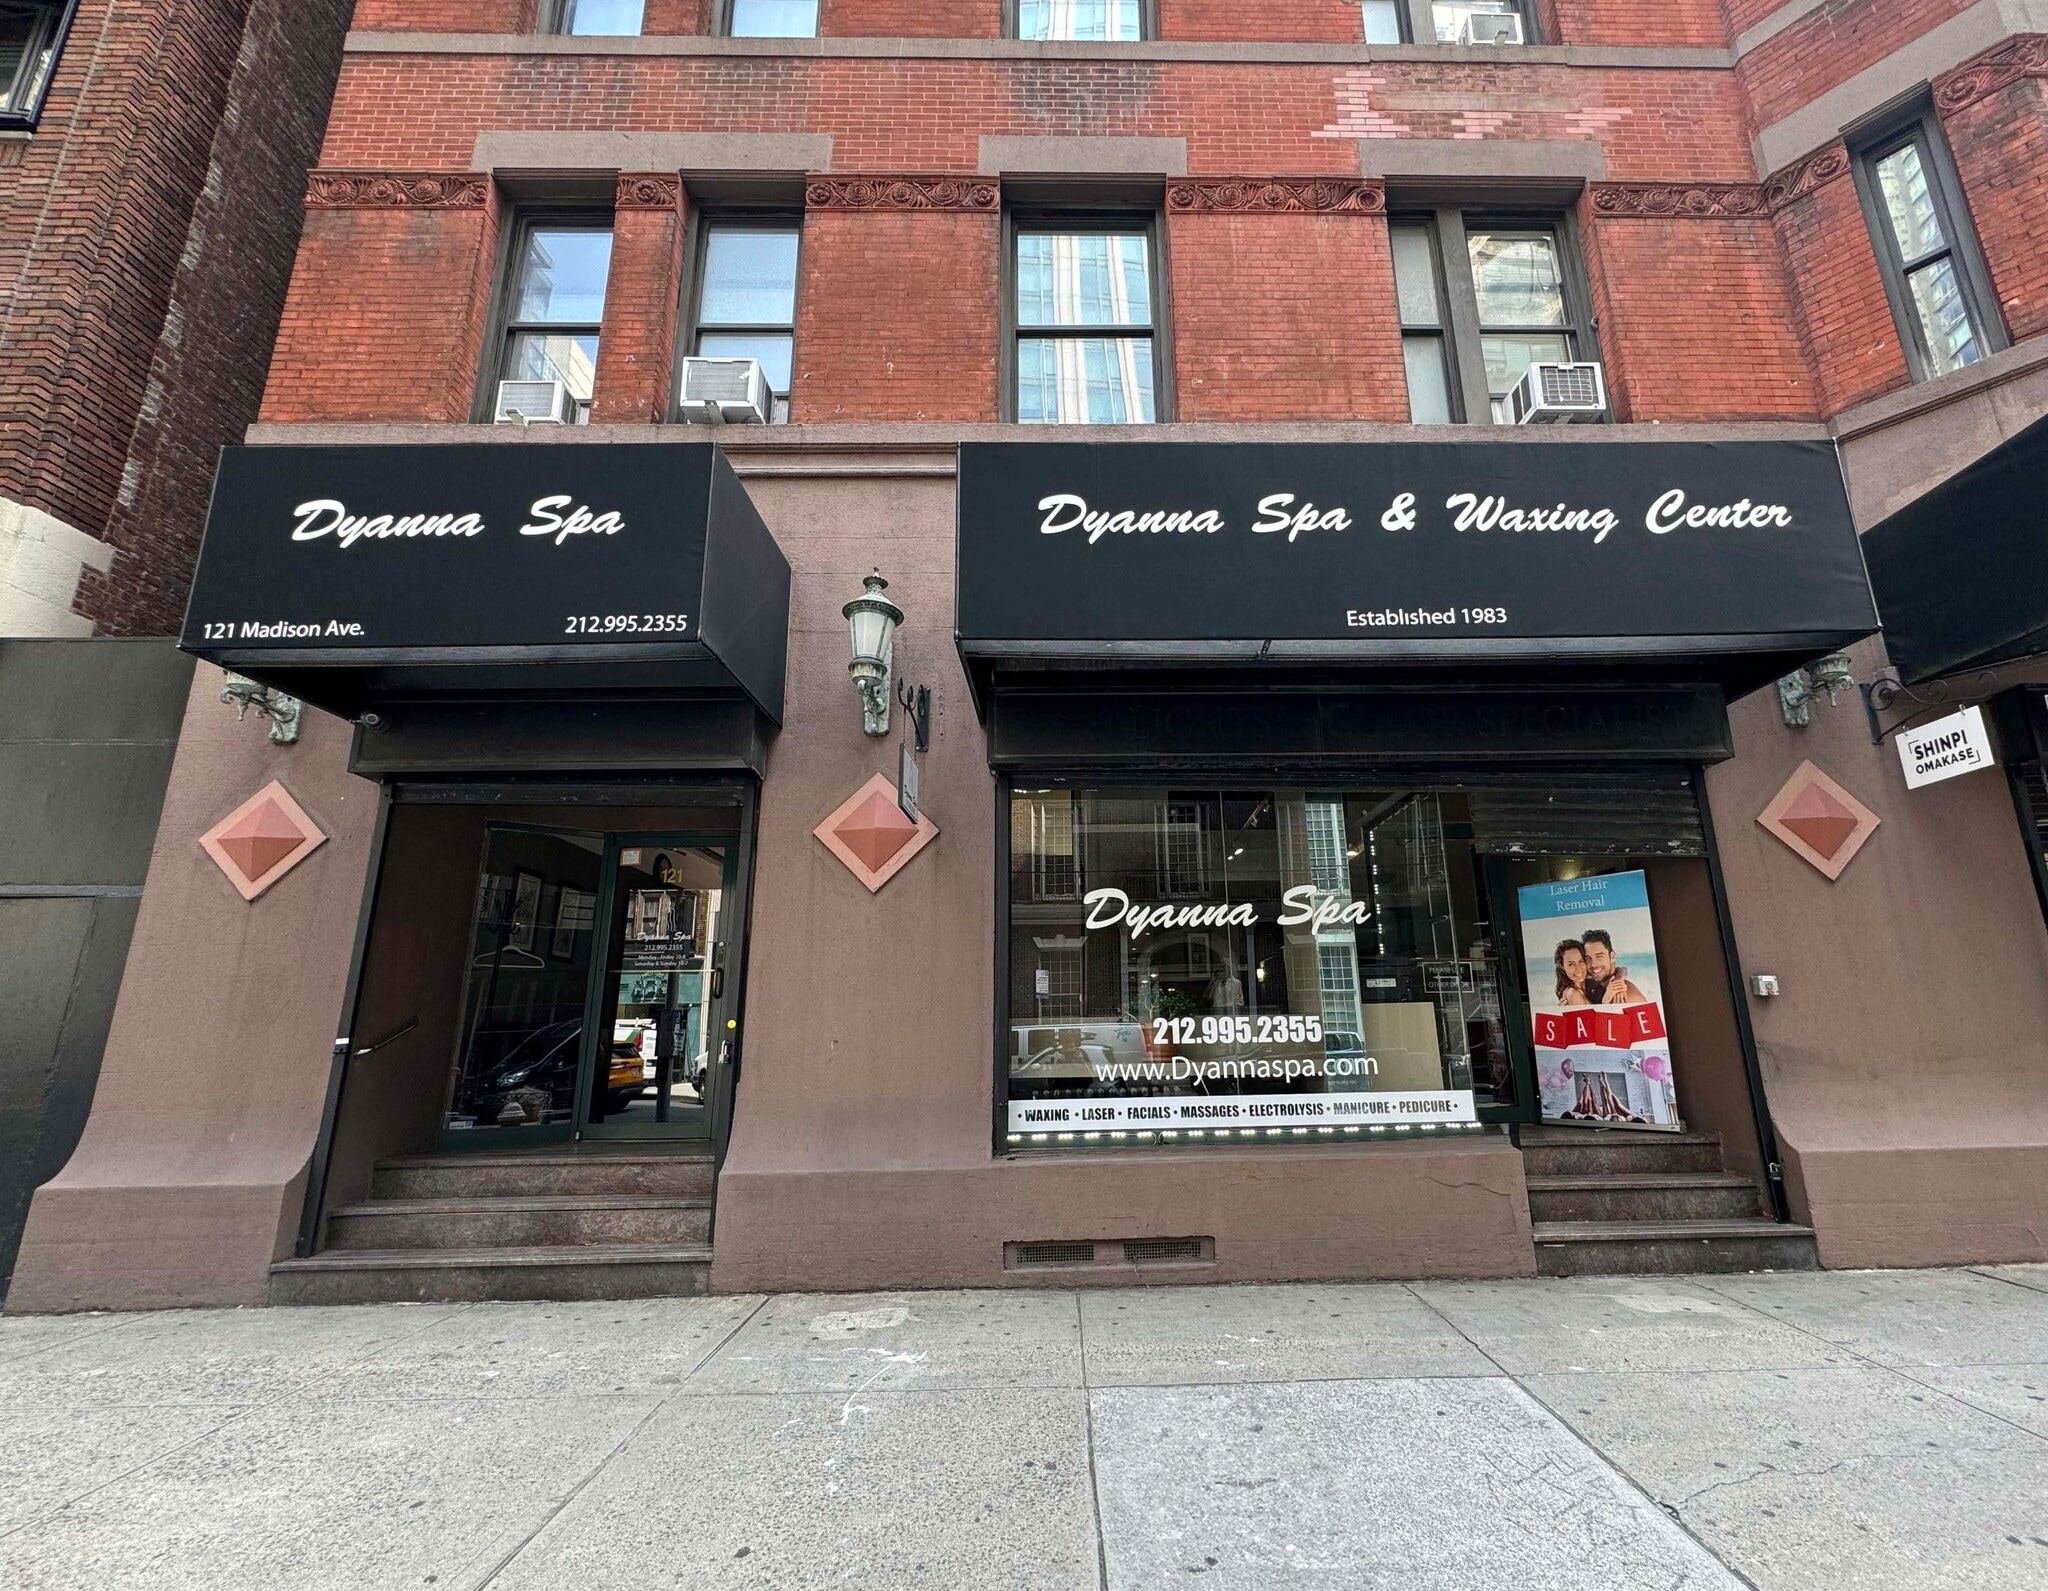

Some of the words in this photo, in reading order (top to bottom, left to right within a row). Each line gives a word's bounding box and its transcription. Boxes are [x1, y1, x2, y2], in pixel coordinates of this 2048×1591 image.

[291, 499, 485, 548] Dyanna
[519, 495, 625, 546] Spa
[1037, 494, 1225, 544] Dyanna
[1252, 493, 1352, 543] Spa
[1380, 492, 1417, 532] &
[1446, 493, 1620, 544] Waxing
[1645, 489, 1793, 535] Center
[565, 614, 688, 634] 212.995.2355
[1346, 608, 1456, 627] Established
[1461, 607, 1508, 625] 1983
[204, 622, 235, 640] 121
[240, 621, 321, 639] Madison
[324, 620, 365, 638] Ave.
[1914, 729, 1968, 760] SHINPI
[1915, 747, 1975, 774] OMAKASE
[661, 868, 683, 883] 121
[1550, 881, 1579, 896] Laser
[1582, 878, 1608, 893] Hair
[1083, 887, 1259, 939] Dyanna
[1276, 884, 1372, 936] Spa
[1556, 895, 1606, 912] Removal
[673, 931, 692, 942] Spa
[1153, 1015, 1323, 1045] 212.995.2355
[1545, 1010, 1651, 1042] SALE
[1095, 1054, 1379, 1085] www.Dyannaspa.com
[1024, 1108, 1070, 1122] WAXING
[1082, 1107, 1115, 1121] LASER
[1127, 1106, 1171, 1119] FACIALS
[1180, 1105, 1240, 1118] MASSAGES
[1249, 1102, 1324, 1117] ELECTROLYSIS
[1333, 1101, 1391, 1115] MANICURE
[1399, 1099, 1452, 1114] PEDICURE
